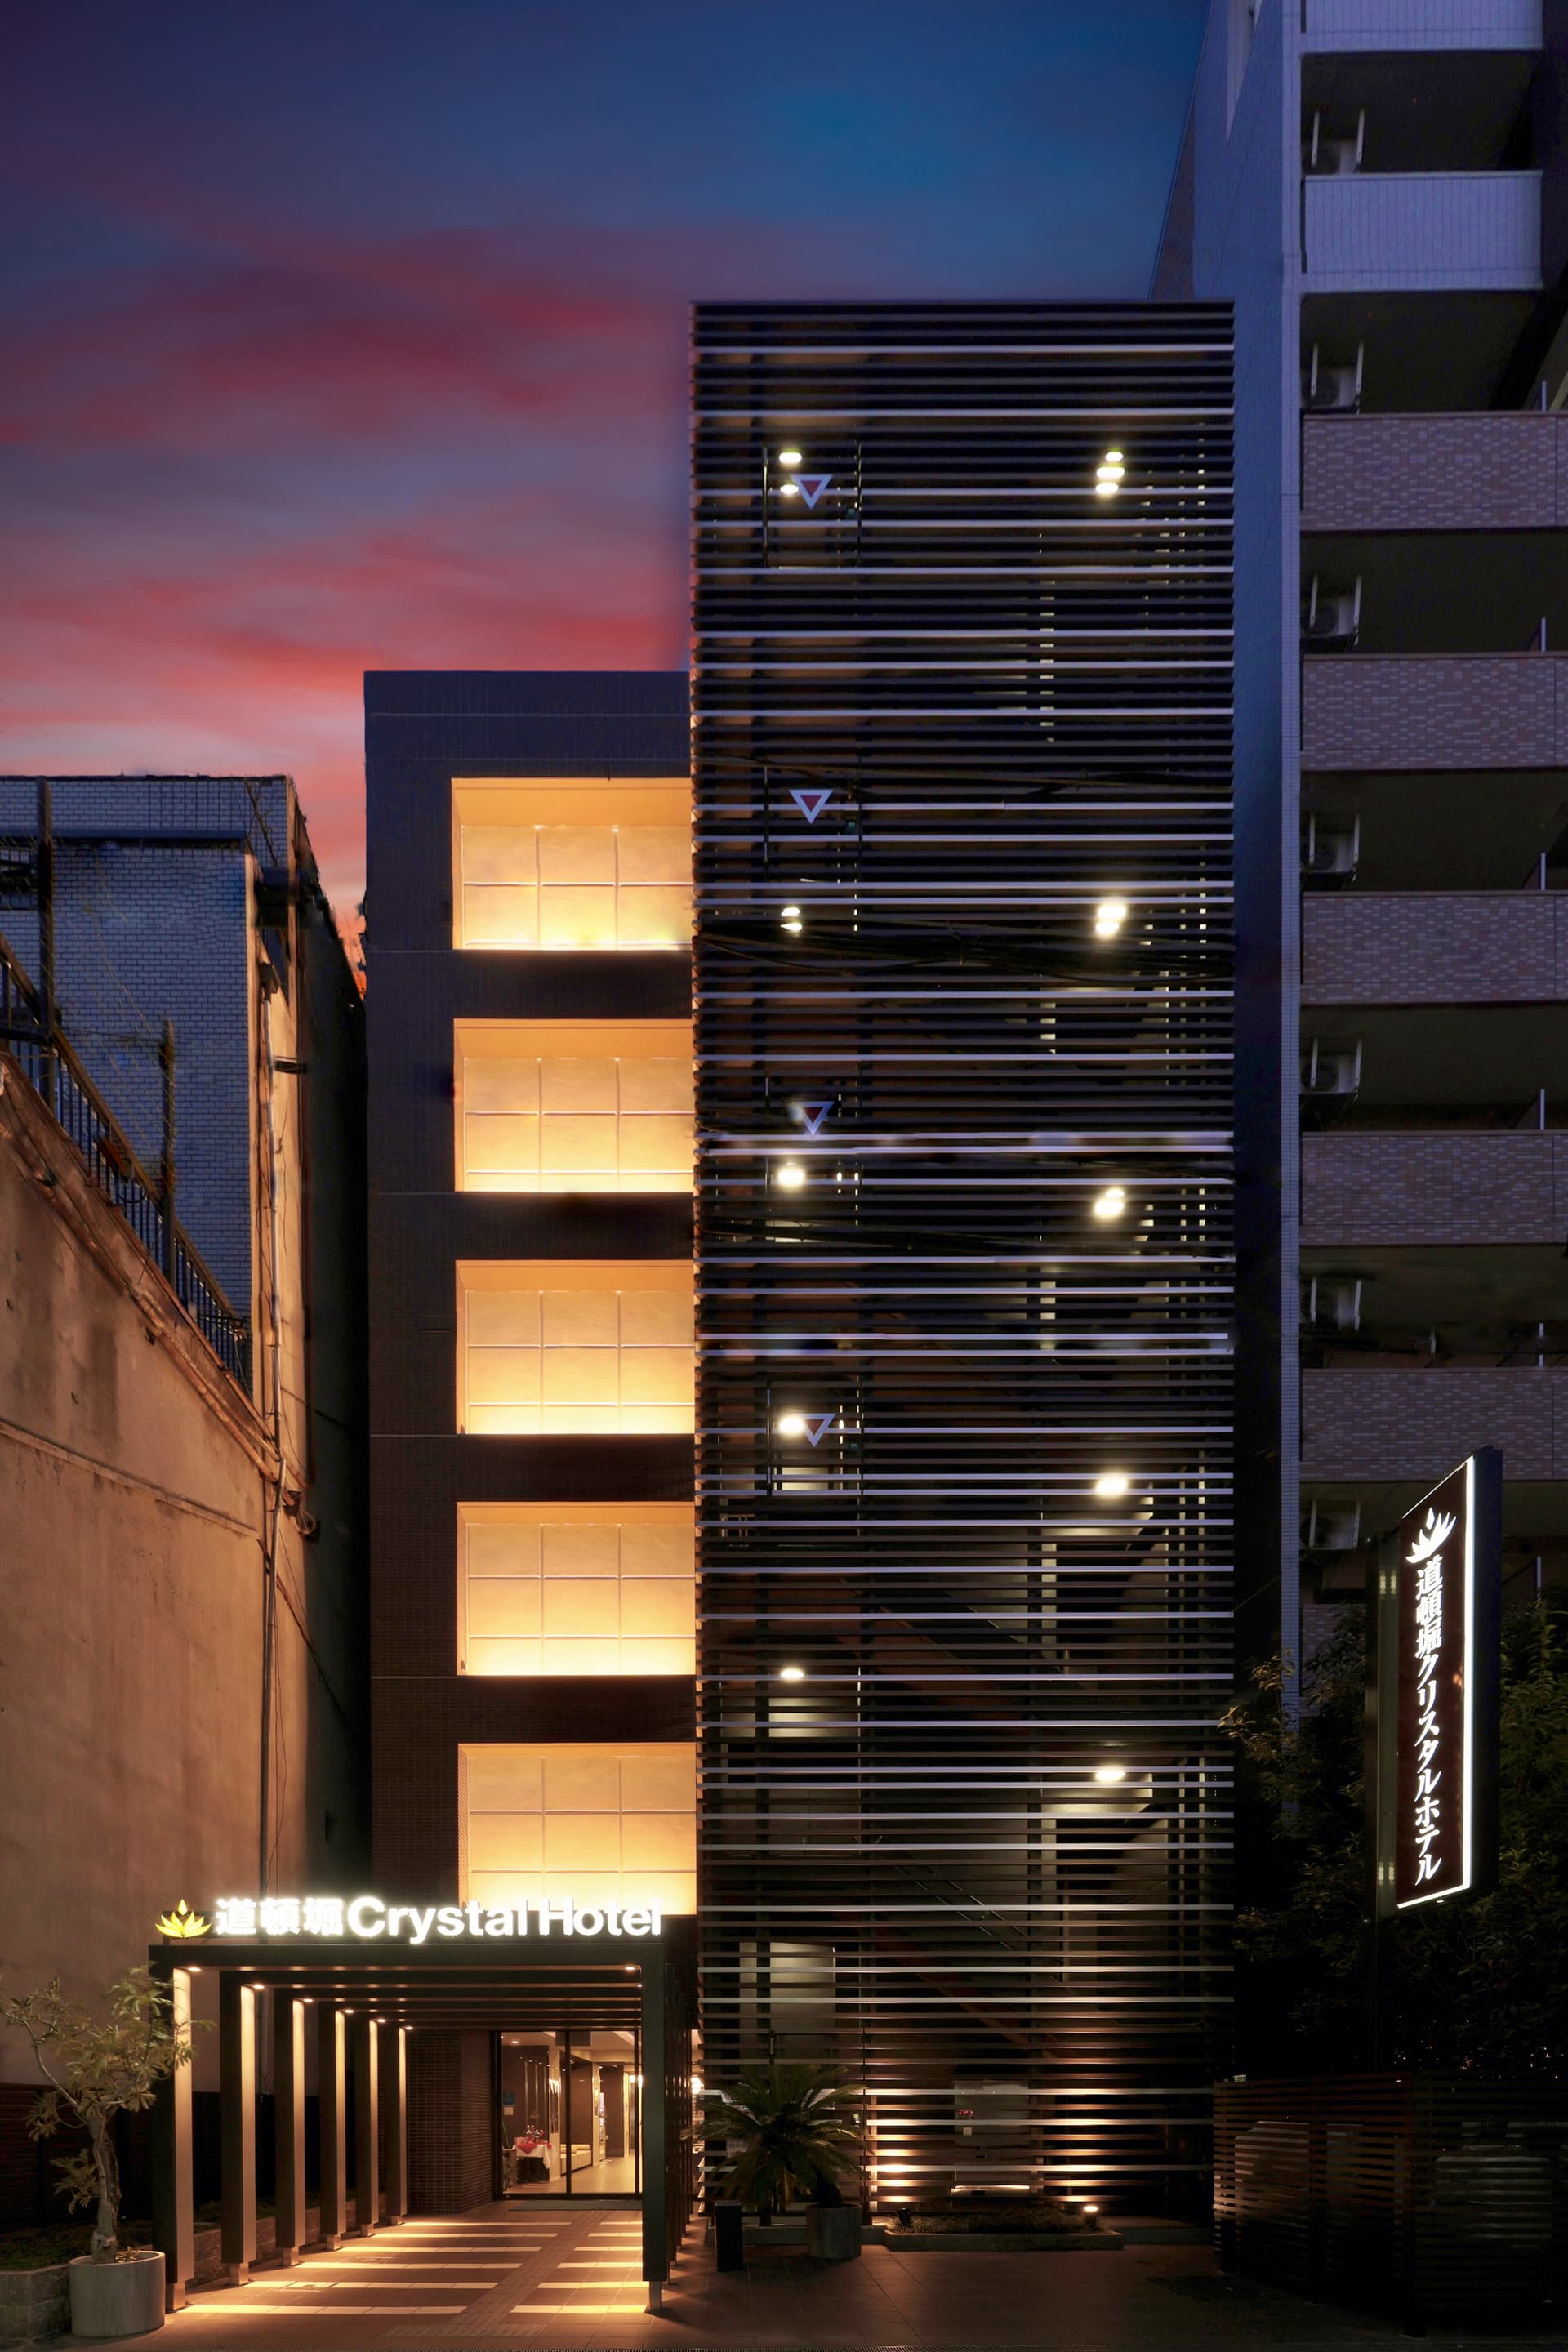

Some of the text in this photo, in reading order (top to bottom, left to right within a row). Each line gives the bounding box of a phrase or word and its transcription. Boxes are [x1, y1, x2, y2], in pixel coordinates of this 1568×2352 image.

[1414, 1554, 1443, 1886] 道頓堀クリスタルホテル
[347, 1895, 528, 1945] Crystal
[537, 1897, 662, 1937] Hotel
